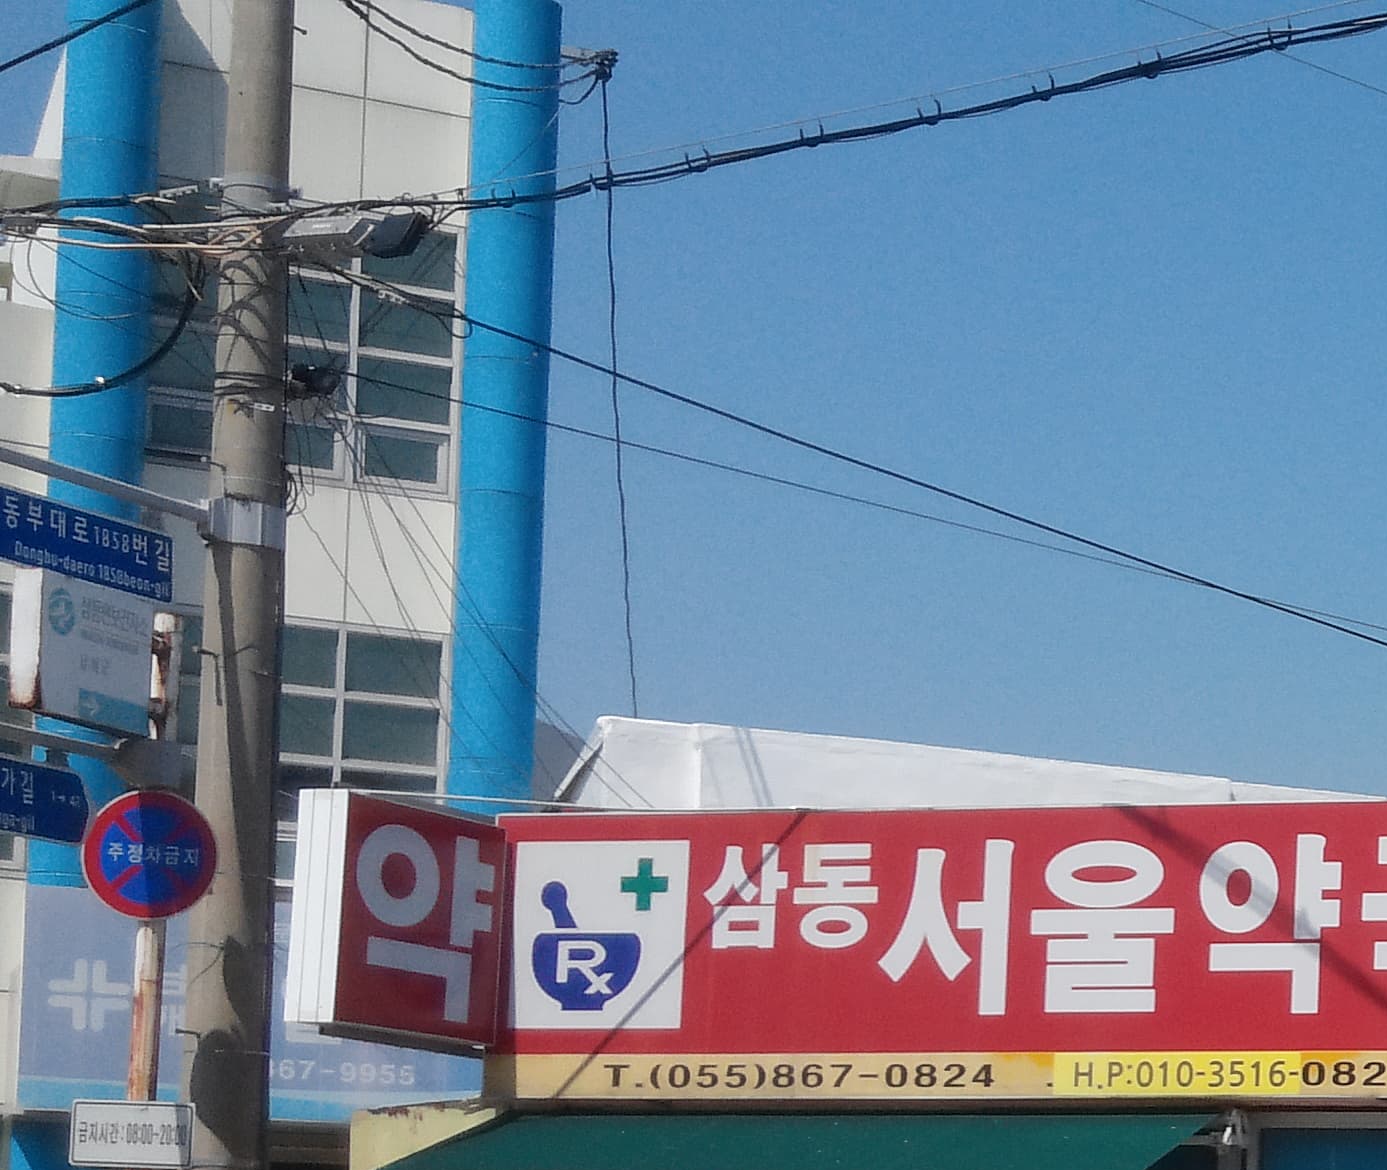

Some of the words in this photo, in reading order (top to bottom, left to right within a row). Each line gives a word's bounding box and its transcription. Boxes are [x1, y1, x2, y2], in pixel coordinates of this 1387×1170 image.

[108, 841, 199, 867] 주정차금지
[703, 843, 880, 949] 삼동
[356, 823, 495, 1024] 약
